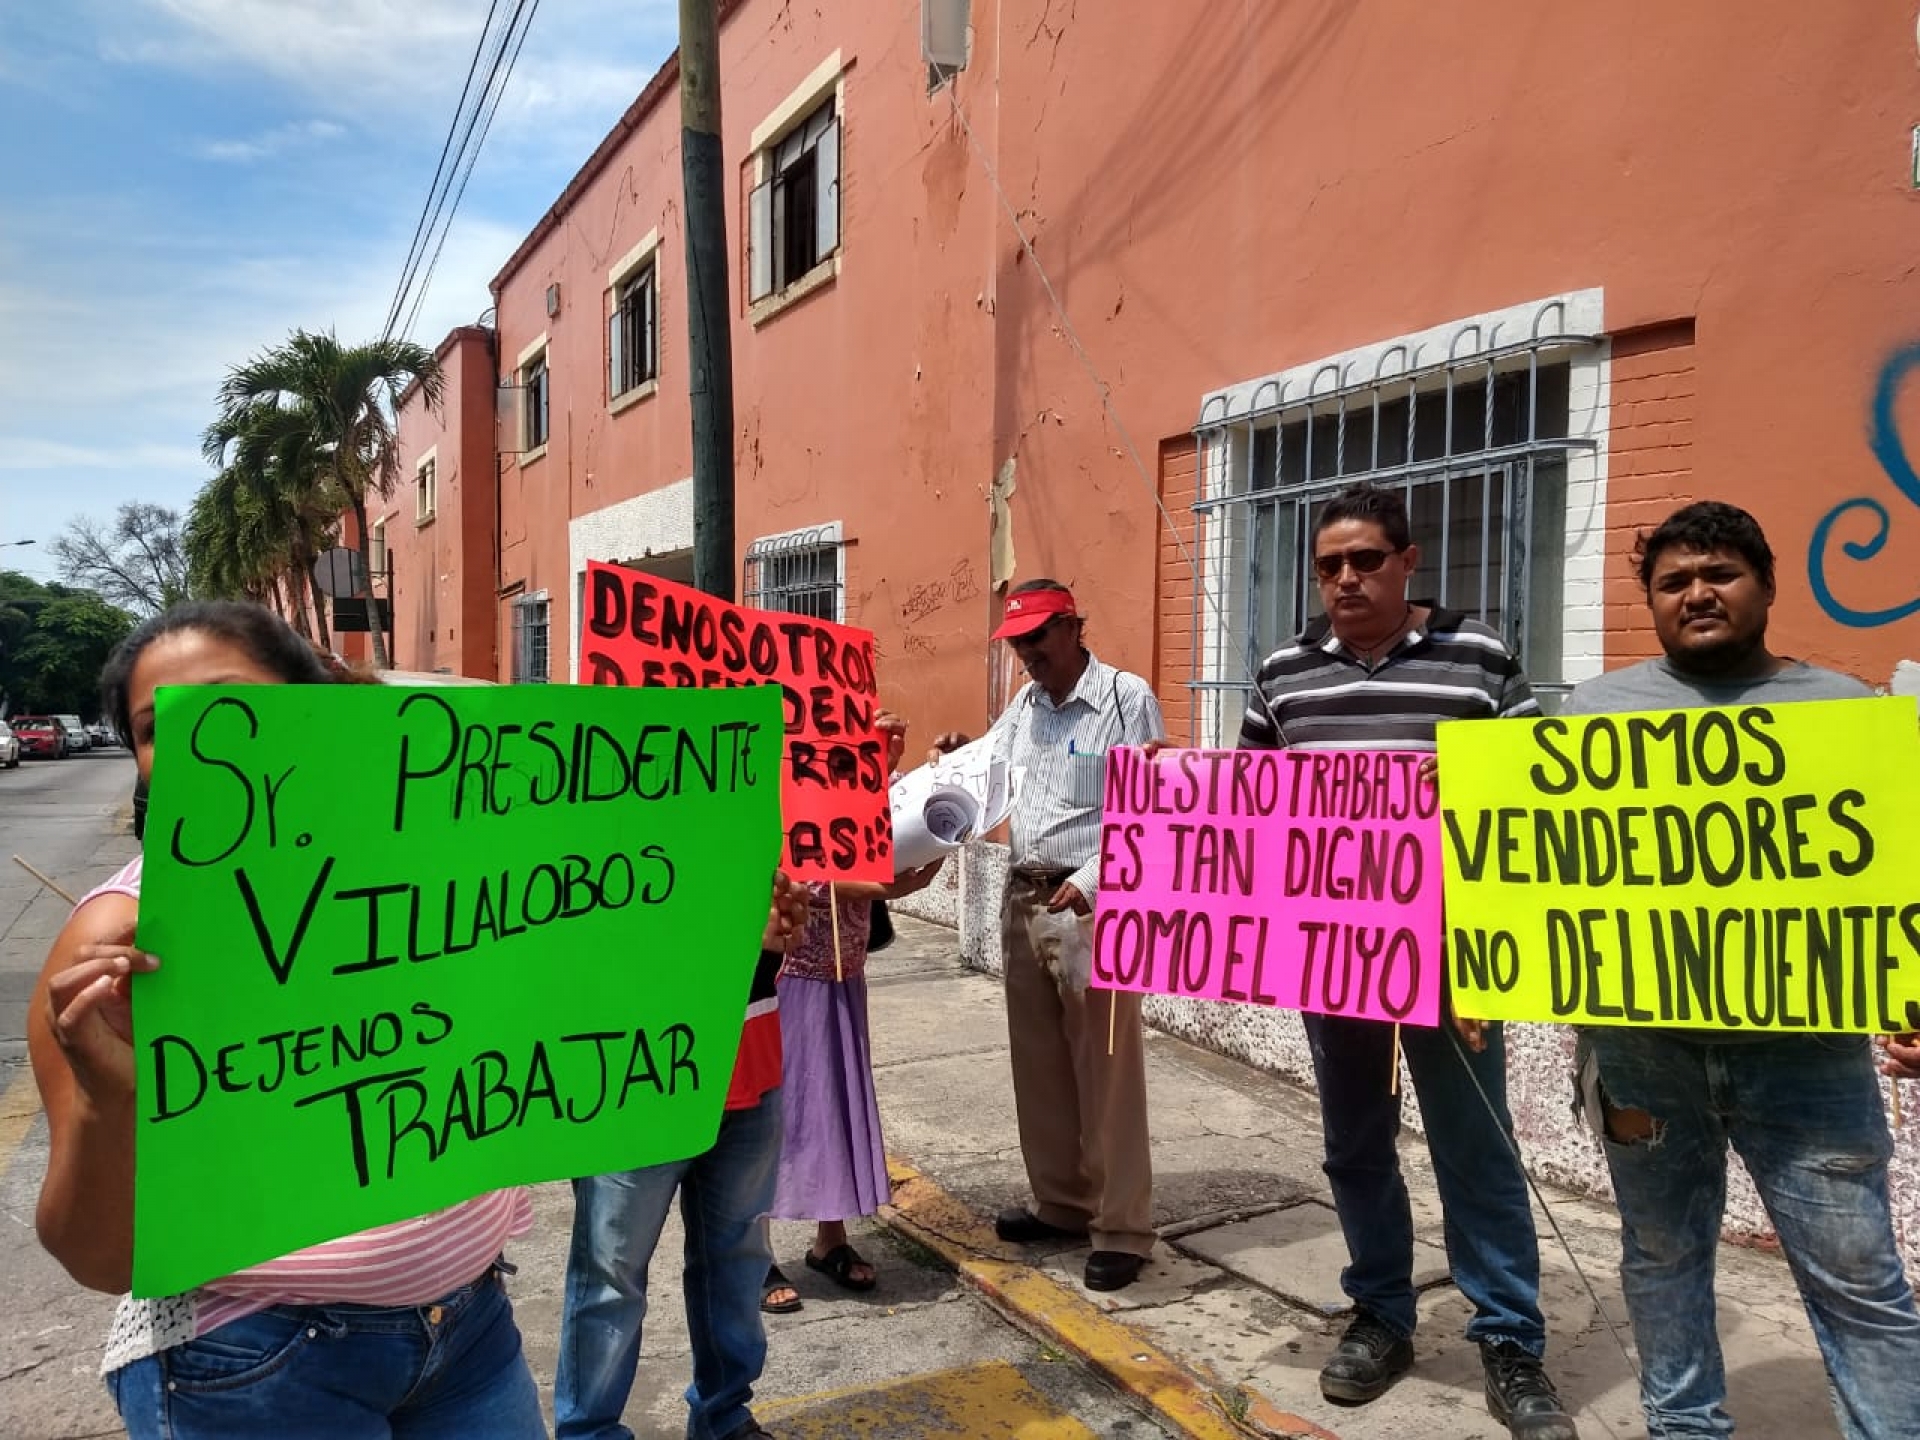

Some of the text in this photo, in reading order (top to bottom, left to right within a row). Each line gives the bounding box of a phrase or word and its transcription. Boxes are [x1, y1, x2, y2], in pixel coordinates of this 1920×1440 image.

[171, 693, 760, 866] Sr. PRESIDENTE
[1105, 751, 1439, 821] NUESTRO TRABAJO
[1530, 707, 1786, 795] SOMOS
[1099, 823, 1423, 904] ES TAN DIGNO
[1443, 789, 1875, 888] VENDEDORES
[235, 845, 675, 985] VILLALOBOS
[1094, 908, 1420, 1019] COMO EL TUYO
[1454, 902, 1920, 1032] NO DELINCUENTES
[149, 1002, 454, 1123] DEJENOS
[294, 1023, 699, 1188] TRABAJAR
